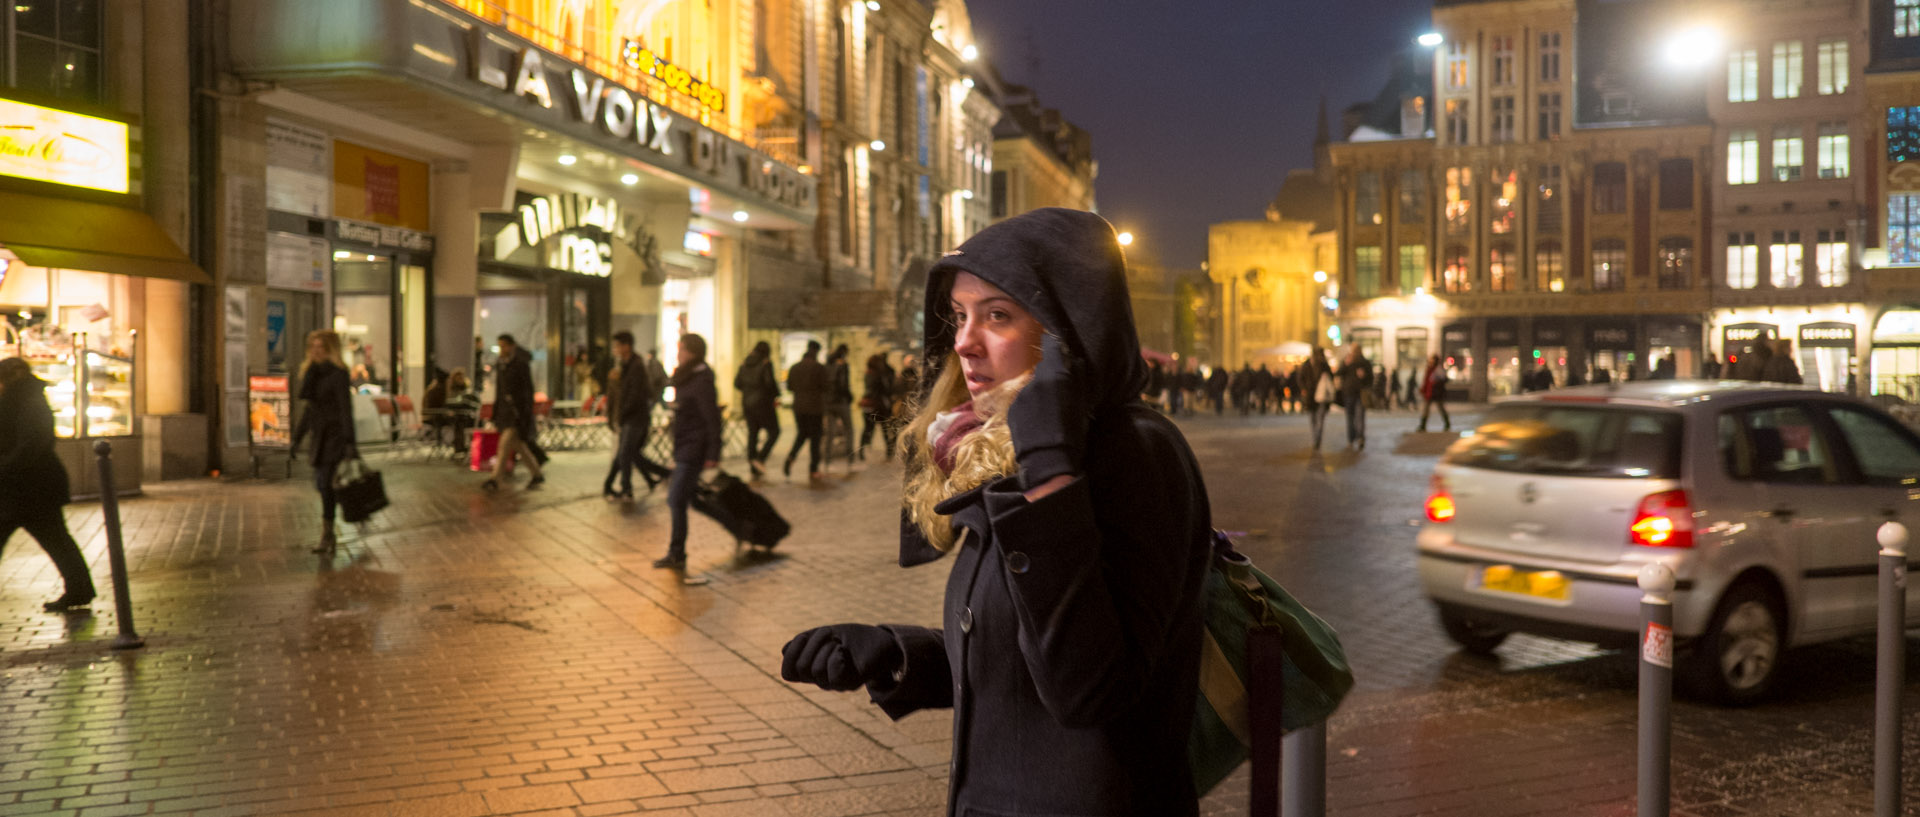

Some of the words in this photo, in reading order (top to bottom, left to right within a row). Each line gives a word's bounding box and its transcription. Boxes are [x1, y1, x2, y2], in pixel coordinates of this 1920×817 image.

[478, 26, 552, 109] LA
[571, 68, 674, 156] VOIX
[698, 128, 732, 178] DU
[749, 150, 810, 207] NORD
[1801, 328, 1853, 340] SEPHORA
